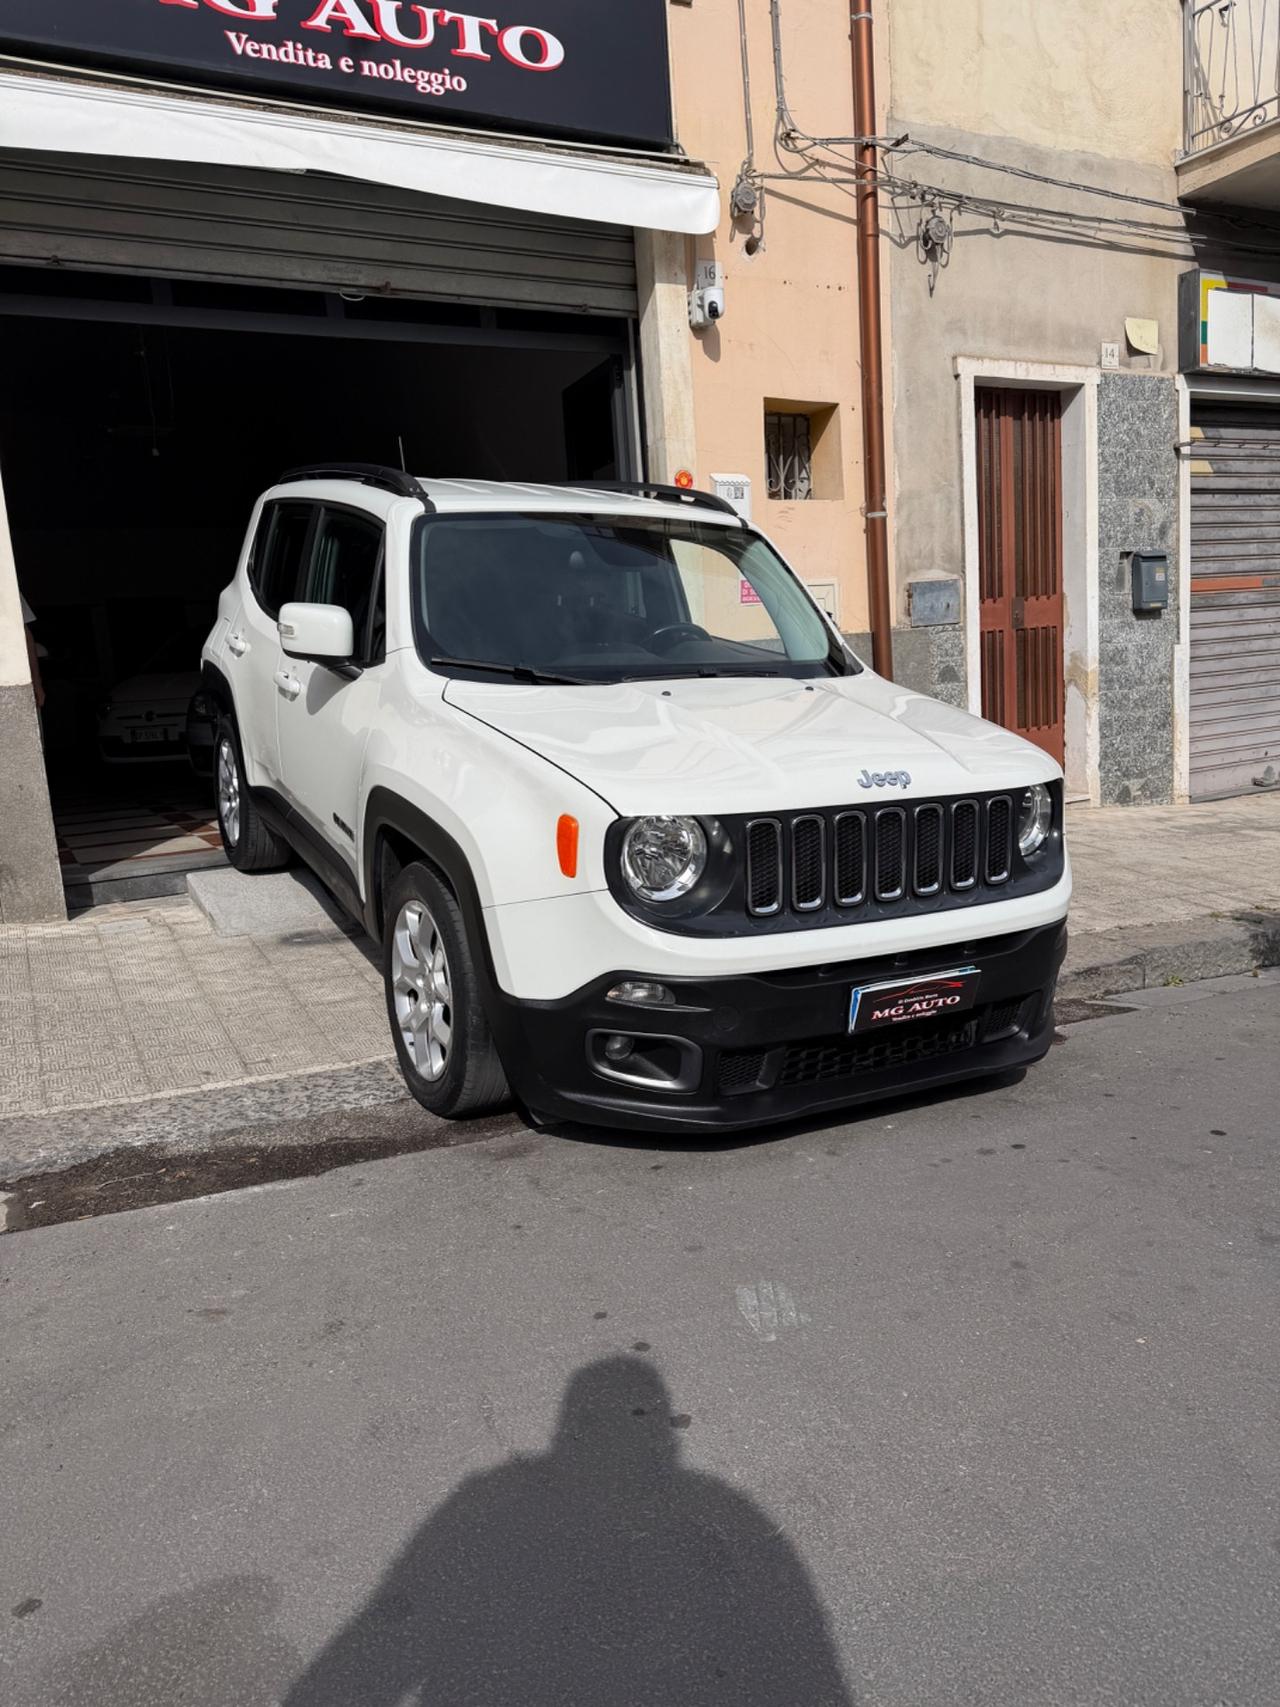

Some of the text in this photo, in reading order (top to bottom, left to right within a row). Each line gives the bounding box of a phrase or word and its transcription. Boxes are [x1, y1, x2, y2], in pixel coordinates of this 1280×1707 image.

[301, 0, 565, 71] AUTO
[224, 29, 468, 96] Vendita e noleggio
[704, 265, 716, 280] 16
[857, 769, 912, 790] Jeep
[871, 1005, 905, 1020] MG
[907, 995, 961, 1013] AUTO
